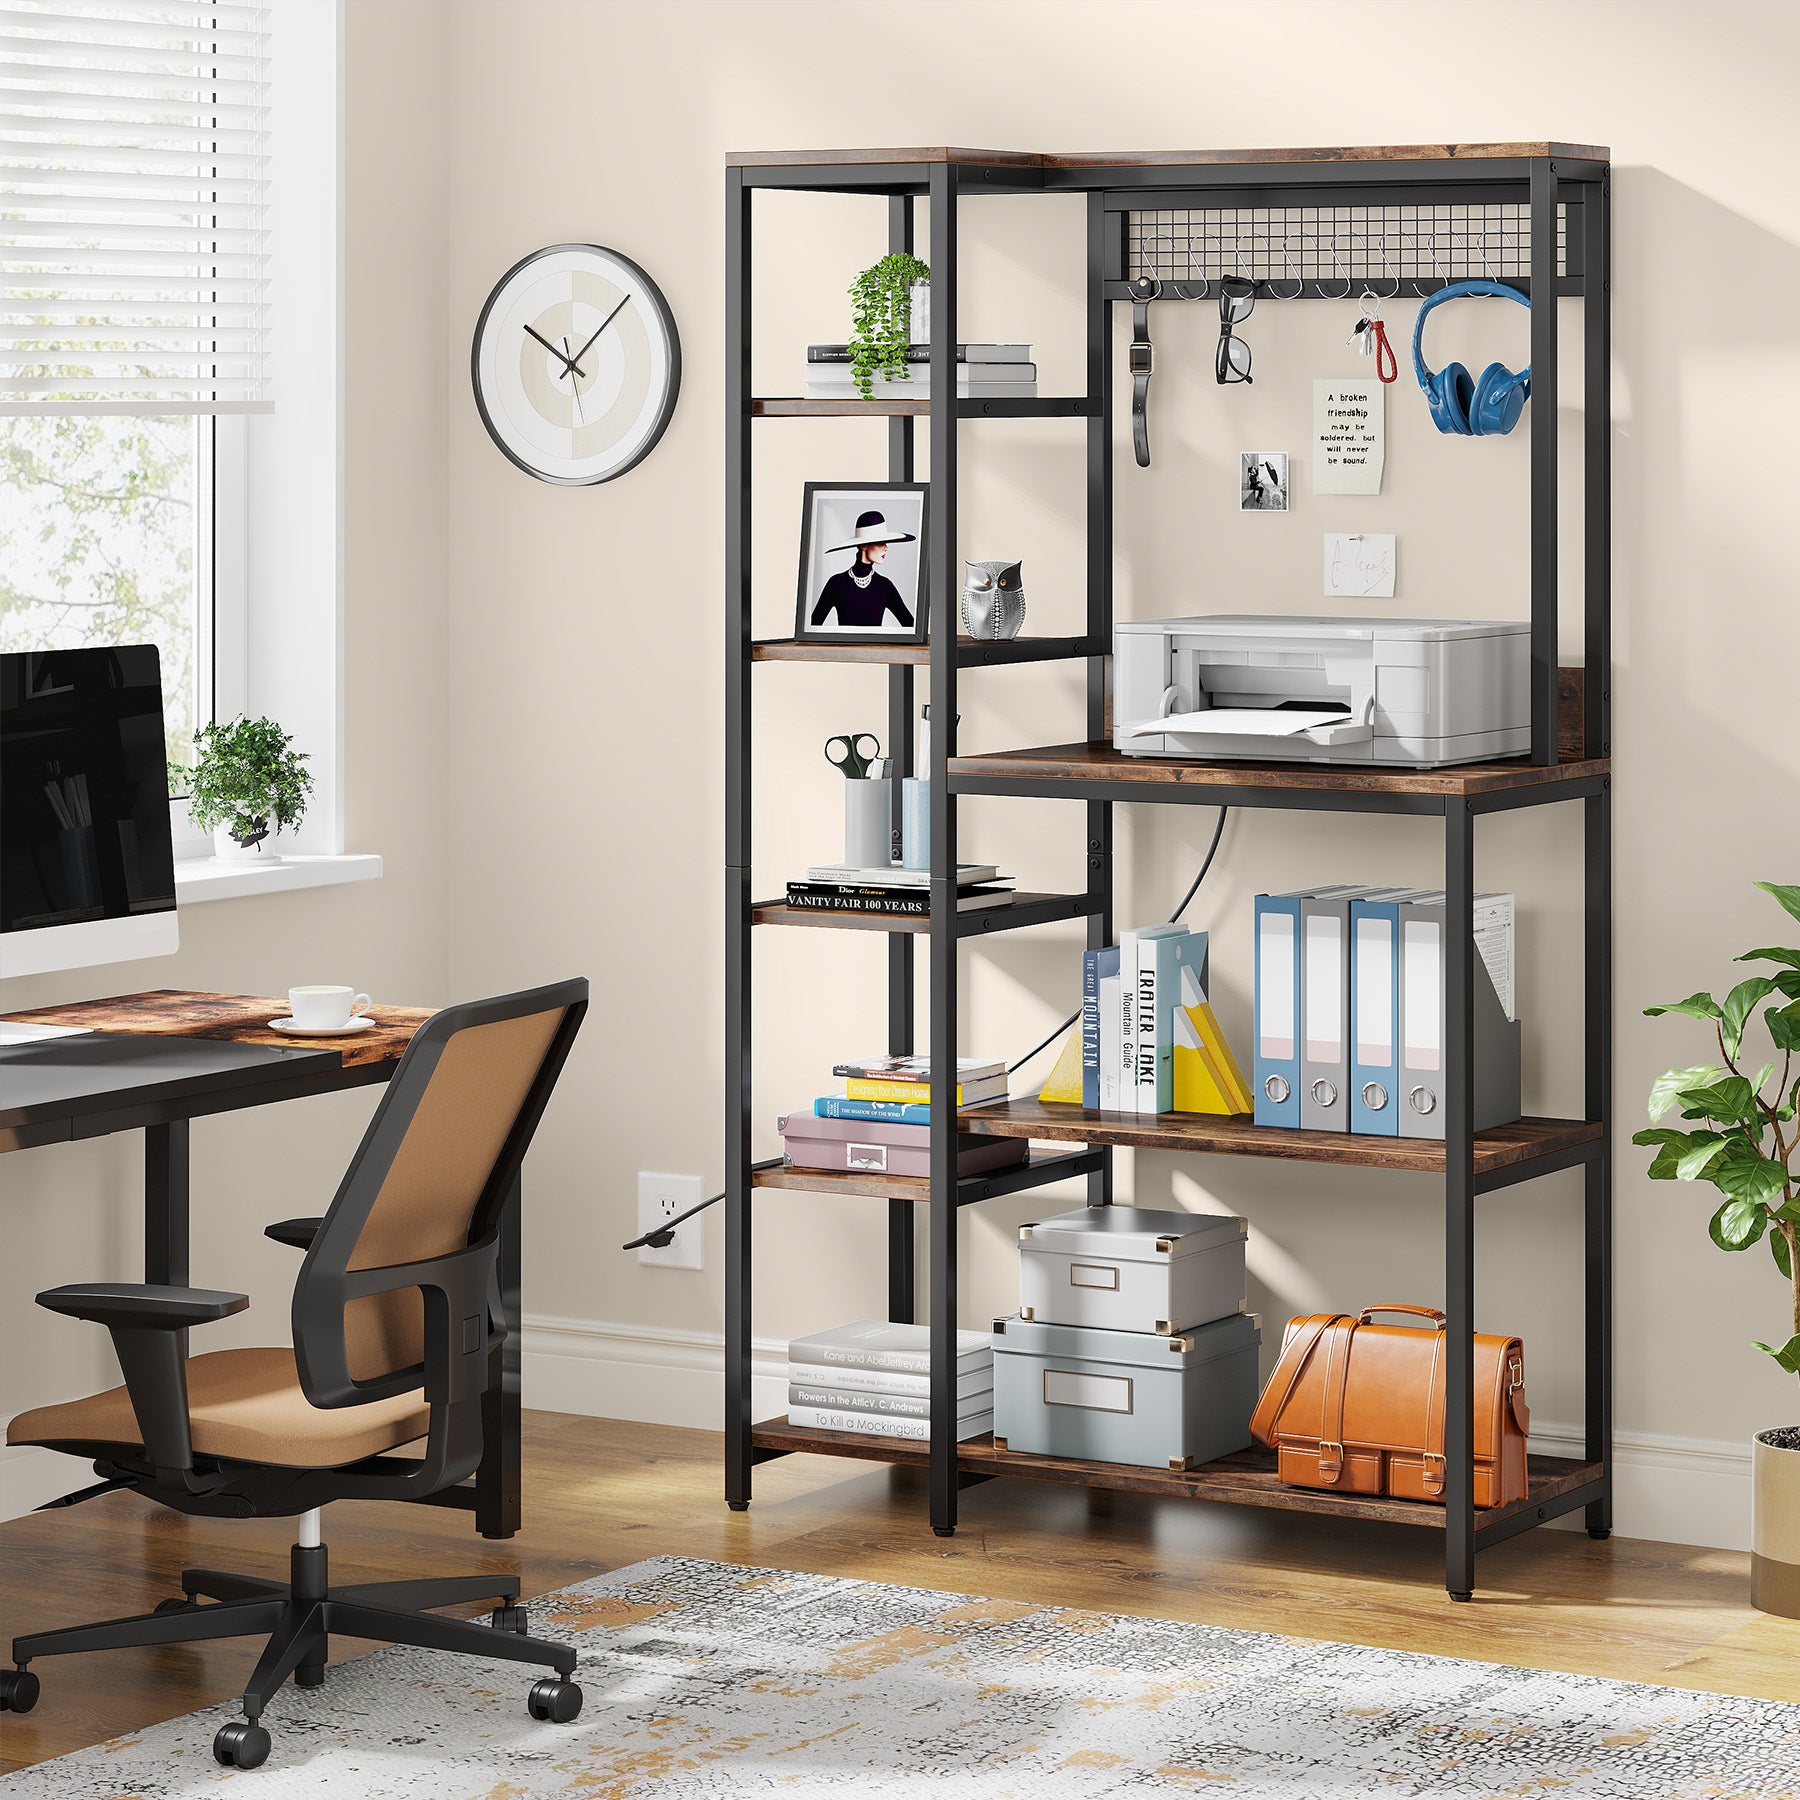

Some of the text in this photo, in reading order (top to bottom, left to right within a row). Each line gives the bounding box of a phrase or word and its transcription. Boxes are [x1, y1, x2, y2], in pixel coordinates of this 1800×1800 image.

[1327, 394, 1368, 402] A broken
[1327, 408, 1368, 419] friendship
[838, 886, 886, 896] Dior Glamour
[788, 895, 922, 912] VANITY FAIR 100 YEARS
[1083, 995, 1098, 1067] MOUNTAIN
[1122, 992, 1134, 1069] Mountain Guide
[1139, 969, 1155, 1086] CRATER LAKE
[849, 1081, 929, 1099] Designing Your Dream Home
[823, 1350, 846, 1361] Kane
[847, 1353, 865, 1363] and
[914, 1360, 930, 1370] Arc
[798, 1390, 827, 1403] Flowers
[828, 1394, 836, 1404] in
[836, 1395, 850, 1405] the
[879, 1400, 888, 1409] C.
[889, 1401, 924, 1413] Andrews
[815, 1413, 925, 1437] To Kill a Mockingbird
